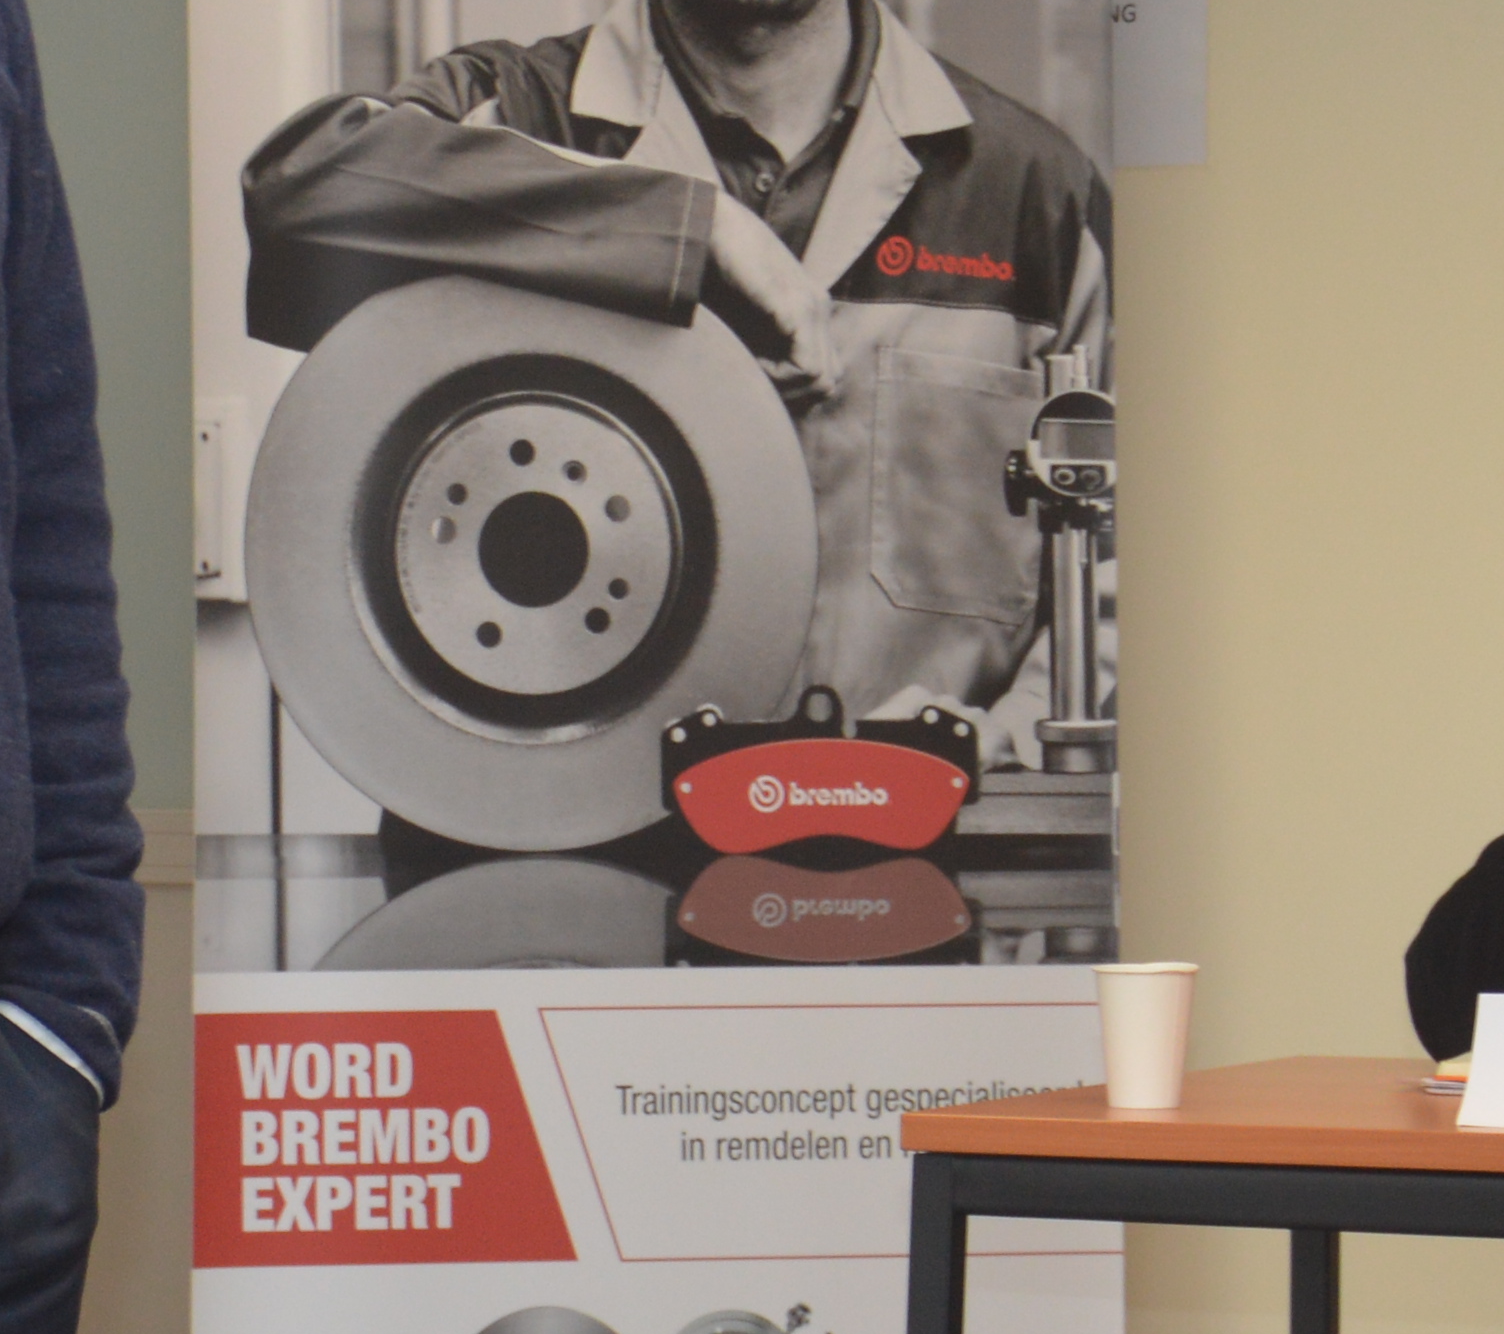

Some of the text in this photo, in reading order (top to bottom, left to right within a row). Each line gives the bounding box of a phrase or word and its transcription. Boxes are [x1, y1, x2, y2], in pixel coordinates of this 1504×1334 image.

[917, 245, 1014, 281] brembo
[789, 781, 889, 806] brembo
[236, 1042, 414, 1100] WORD
[615, 1083, 857, 1121] Trainingsconcept
[241, 1106, 491, 1167] BREMBO
[680, 1130, 892, 1161] in remdelen en
[241, 1173, 463, 1233] EXPERT
